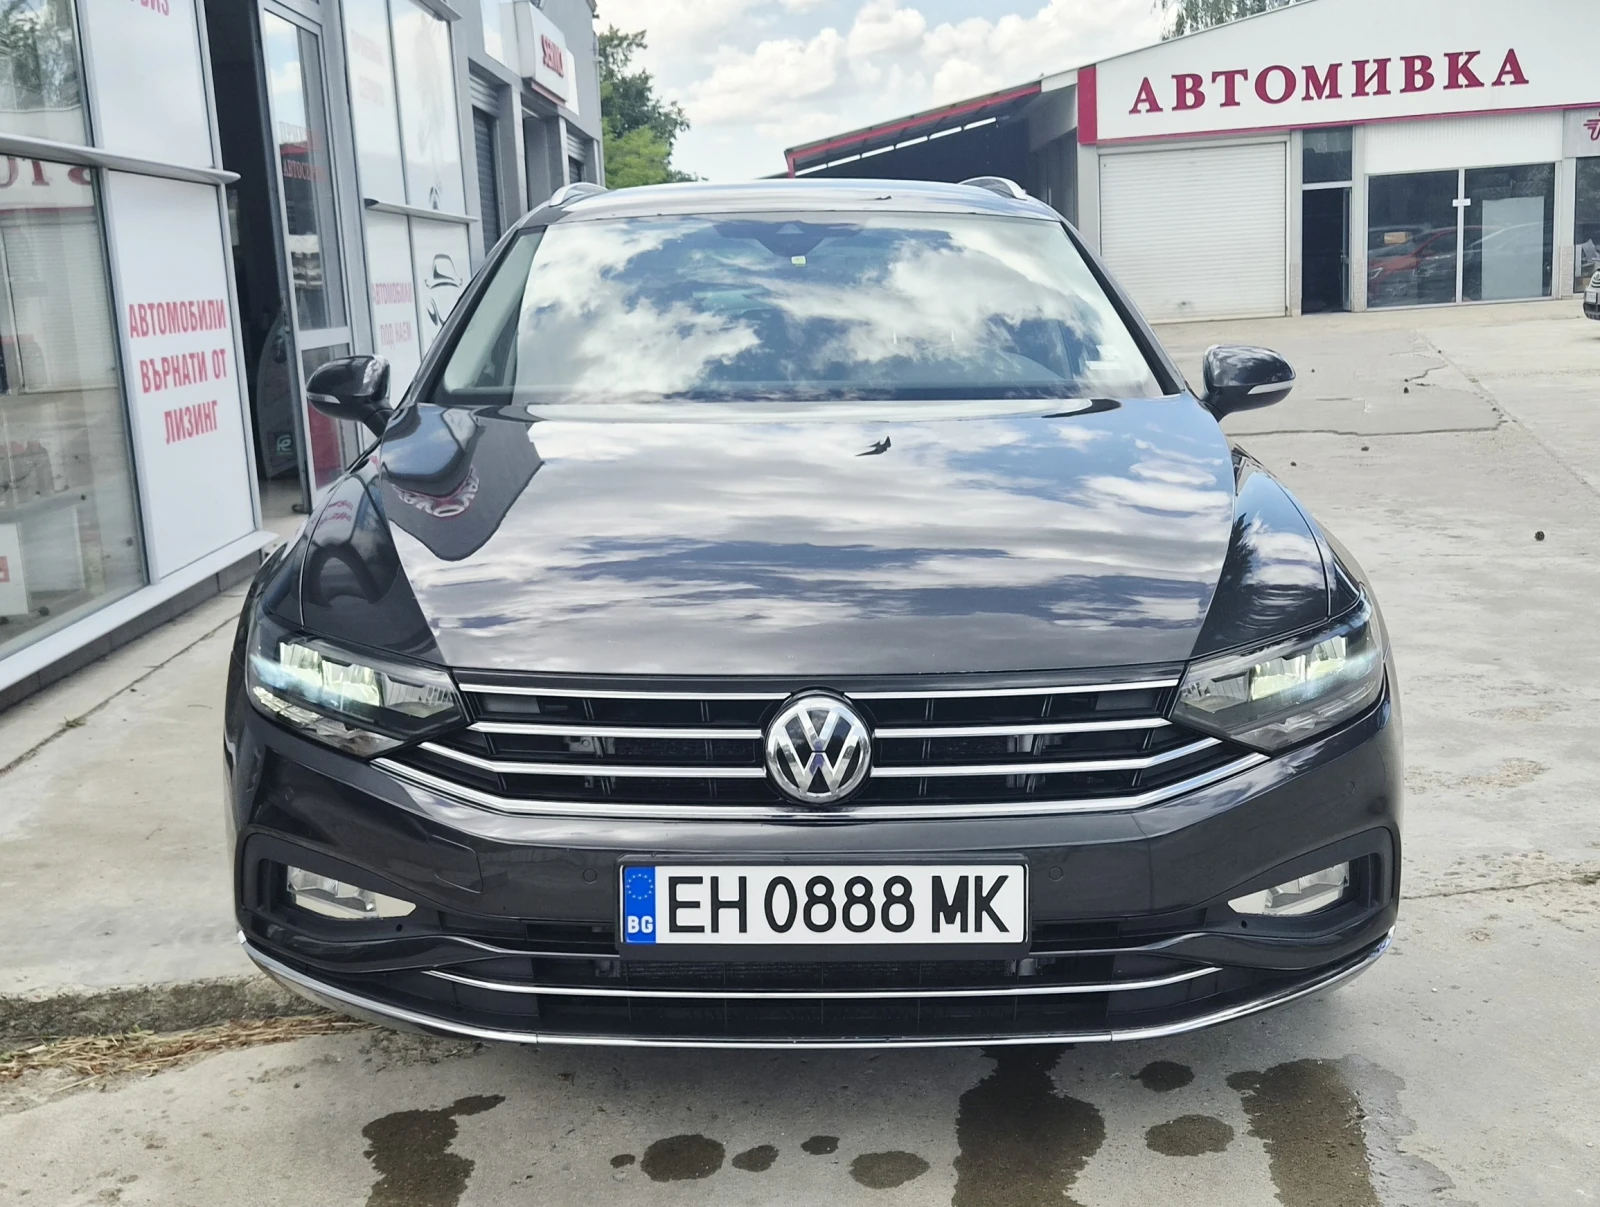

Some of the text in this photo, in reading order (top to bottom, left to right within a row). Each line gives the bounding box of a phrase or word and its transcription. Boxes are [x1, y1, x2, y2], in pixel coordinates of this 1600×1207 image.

[1128, 47, 1530, 115] АВТОМИВКА
[128, 299, 227, 339] АВТОМОБИЛИ
[139, 348, 228, 394] ВЪРНАТИ ОТ
[163, 399, 219, 445] ЛИЗИНГ
[626, 915, 654, 934] BG
[667, 874, 1011, 934] EH 0888 MK
